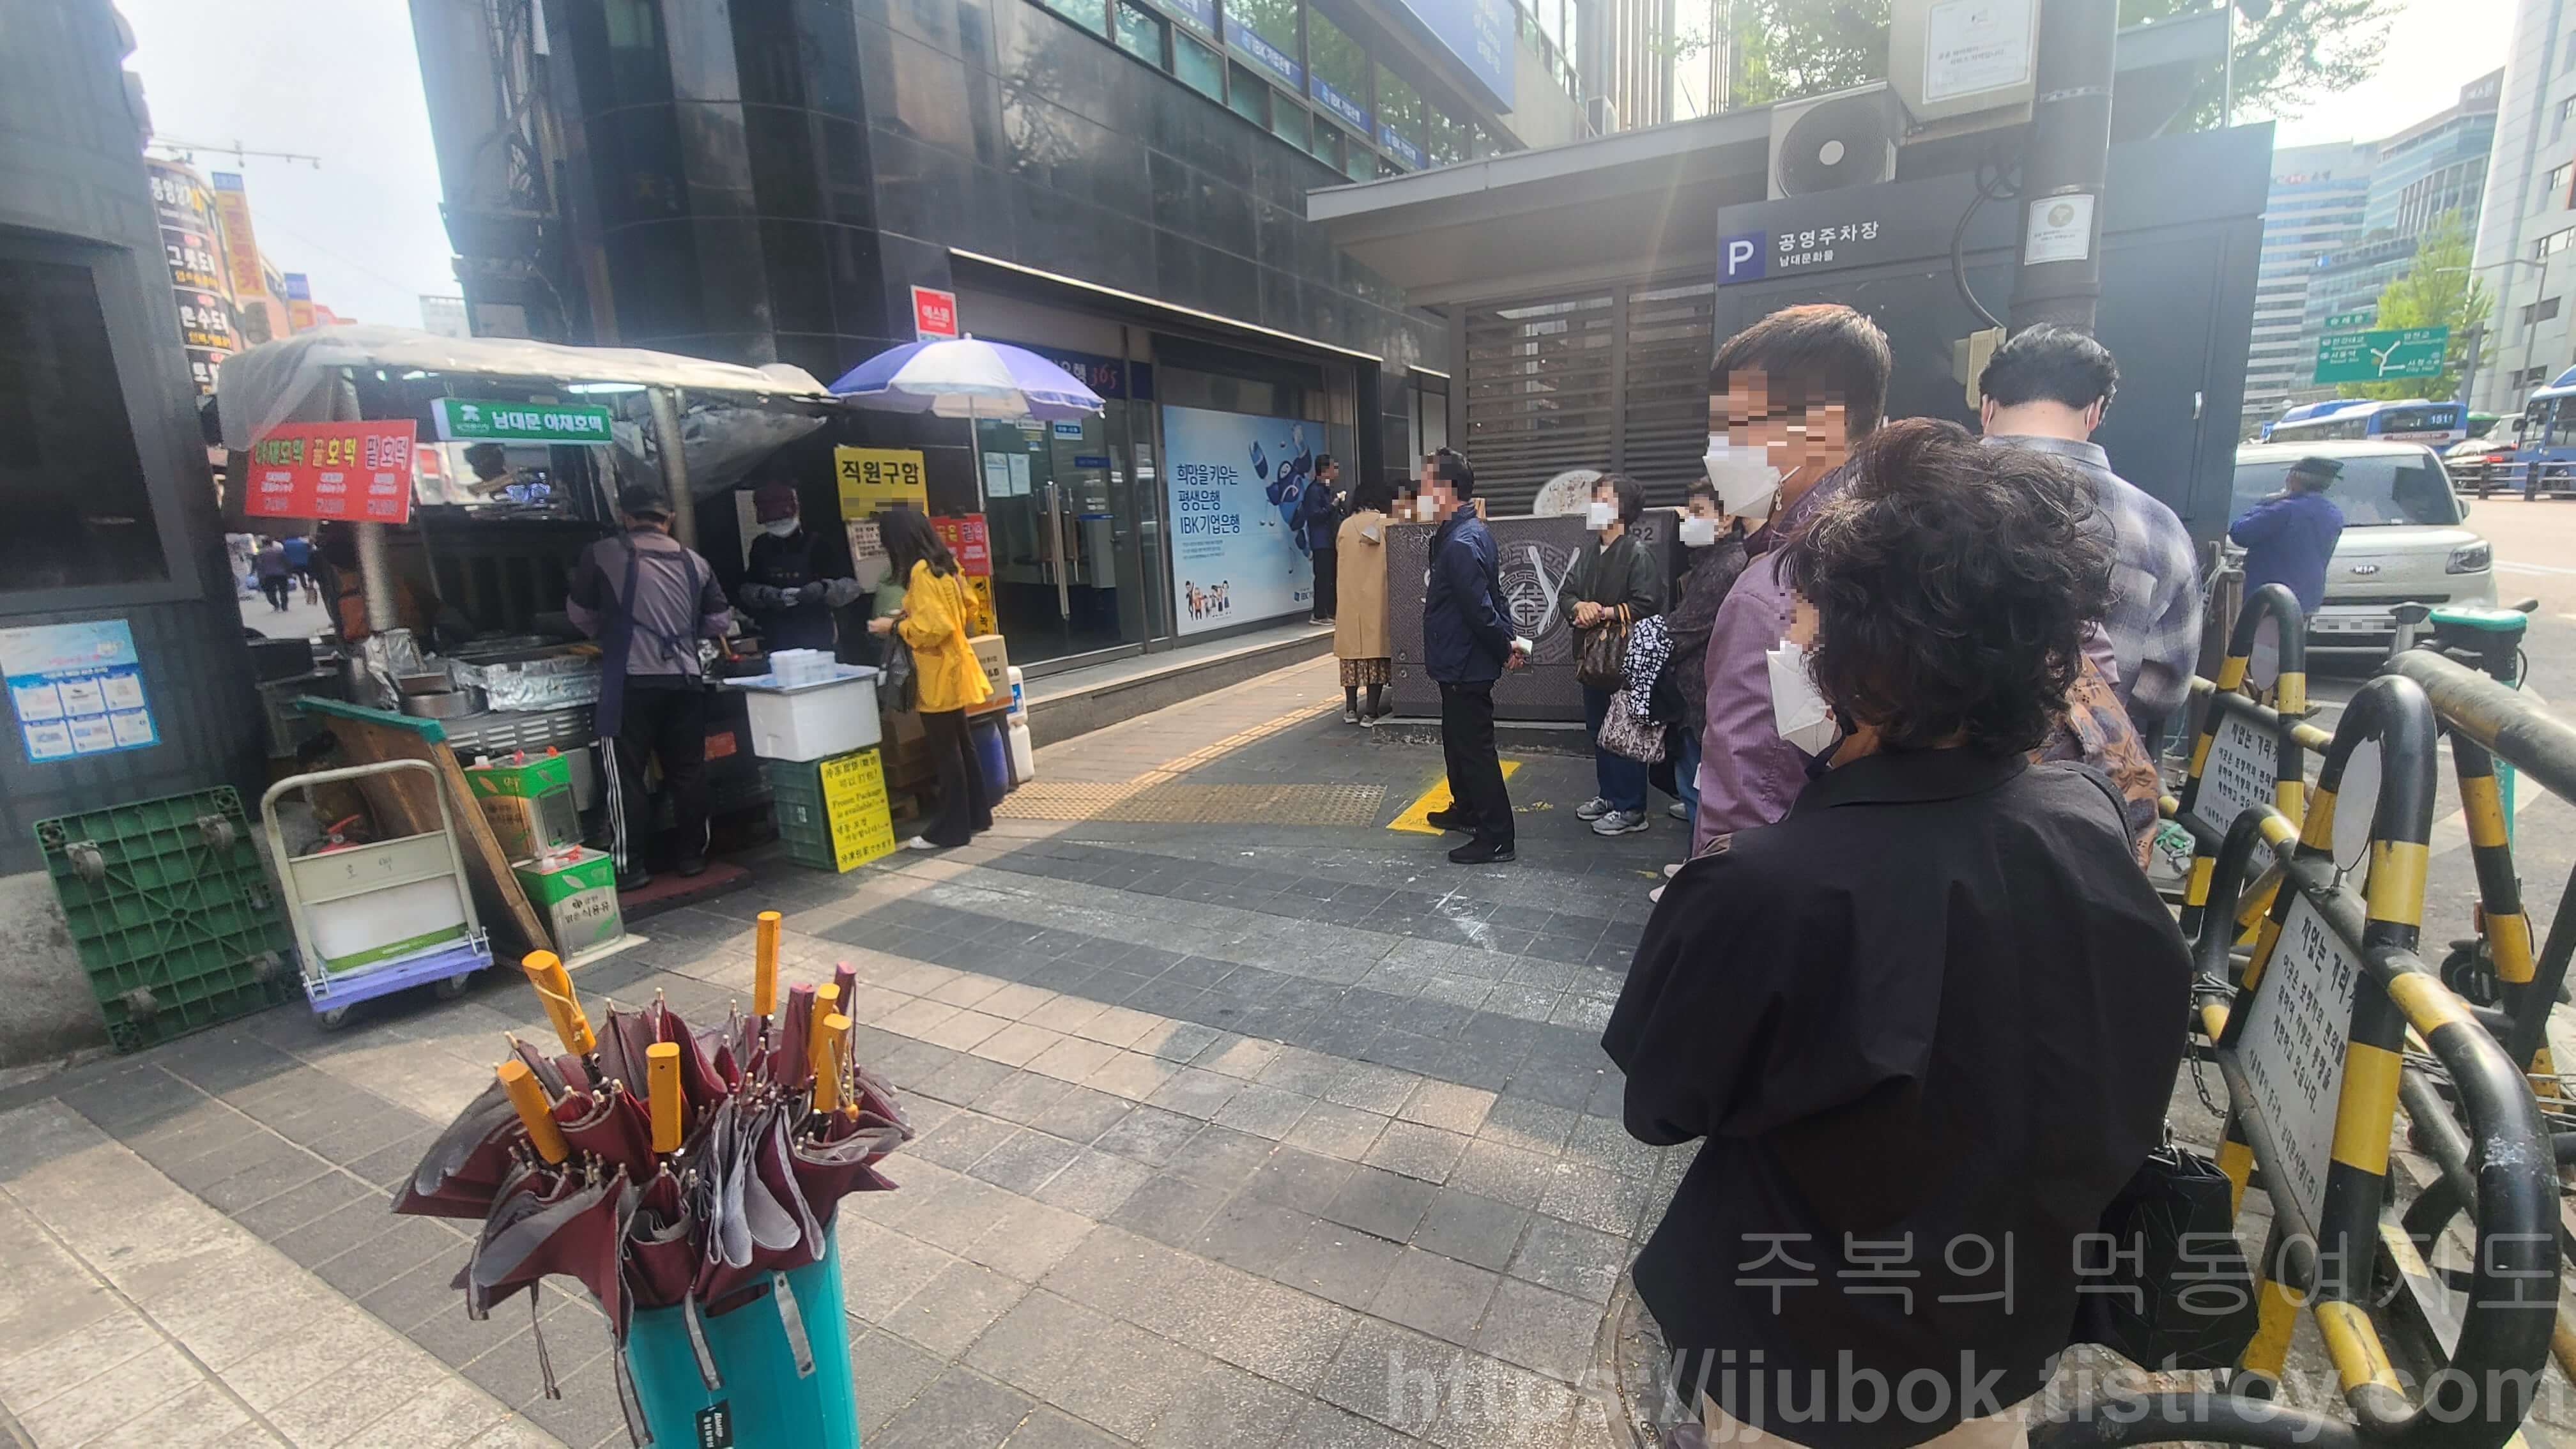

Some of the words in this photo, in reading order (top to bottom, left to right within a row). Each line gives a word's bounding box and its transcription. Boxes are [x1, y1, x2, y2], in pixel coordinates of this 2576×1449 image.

[1778, 220, 1879, 252] 공영주차장
[1728, 240, 1754, 275] P
[491, 411, 542, 431] 남대문
[841, 460, 919, 484] 직원구함
[1176, 463, 1209, 486] 희망을
[1209, 464, 1239, 486] 키우는
[1177, 490, 1221, 511] 평생은행
[1180, 514, 1240, 535] IBK기업은행
[2301, 916, 2327, 973] 차없는
[2331, 953, 2351, 1004] 거리
[2278, 984, 2296, 1023] 위하여
[2283, 953, 2299, 991] 이곳은
[2299, 981, 2325, 1031] 보행자의
[2323, 1020, 2346, 1068] 편의를
[2293, 1055, 2317, 1114] 있습니다.
